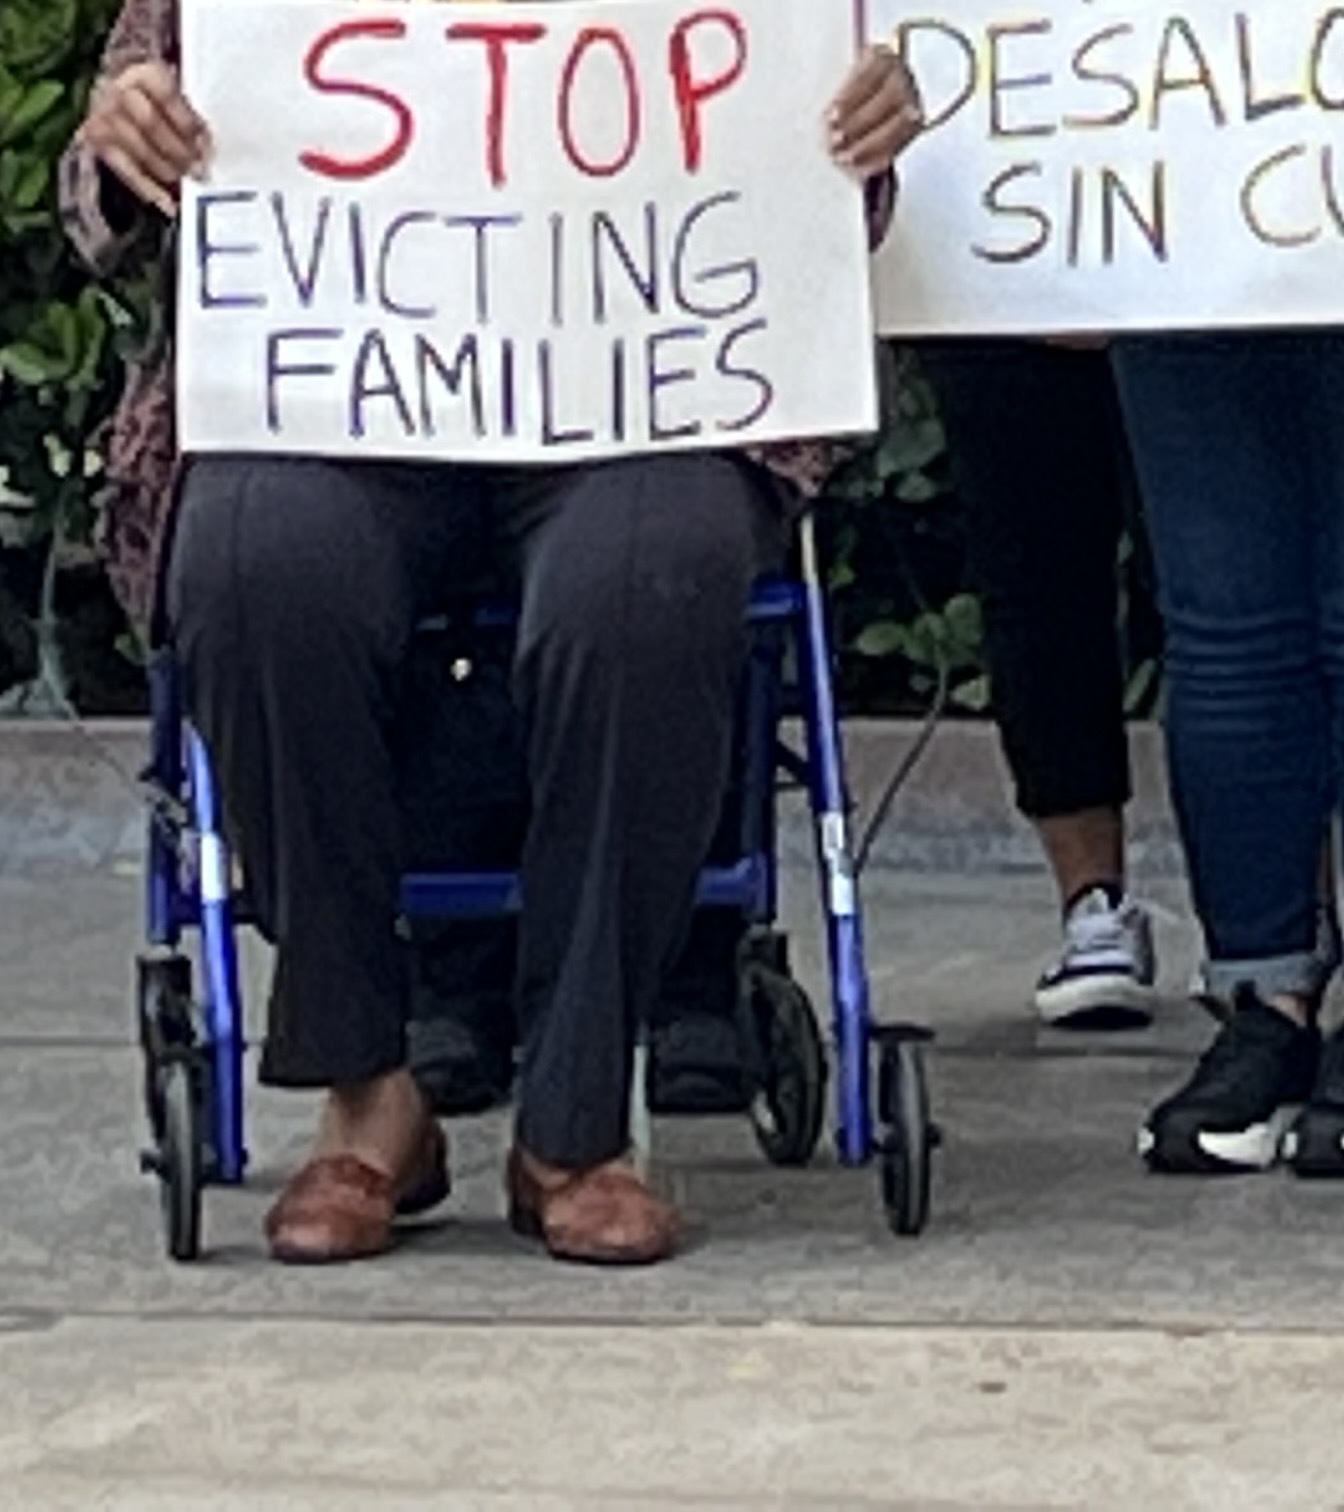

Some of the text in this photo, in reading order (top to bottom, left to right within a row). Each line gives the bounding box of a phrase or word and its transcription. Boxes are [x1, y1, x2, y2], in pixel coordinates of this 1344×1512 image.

[298, 9, 748, 190] STOP
[196, 190, 760, 325] EVICTING
[971, 159, 1168, 270] SIN
[265, 319, 774, 447] FAMILIES
